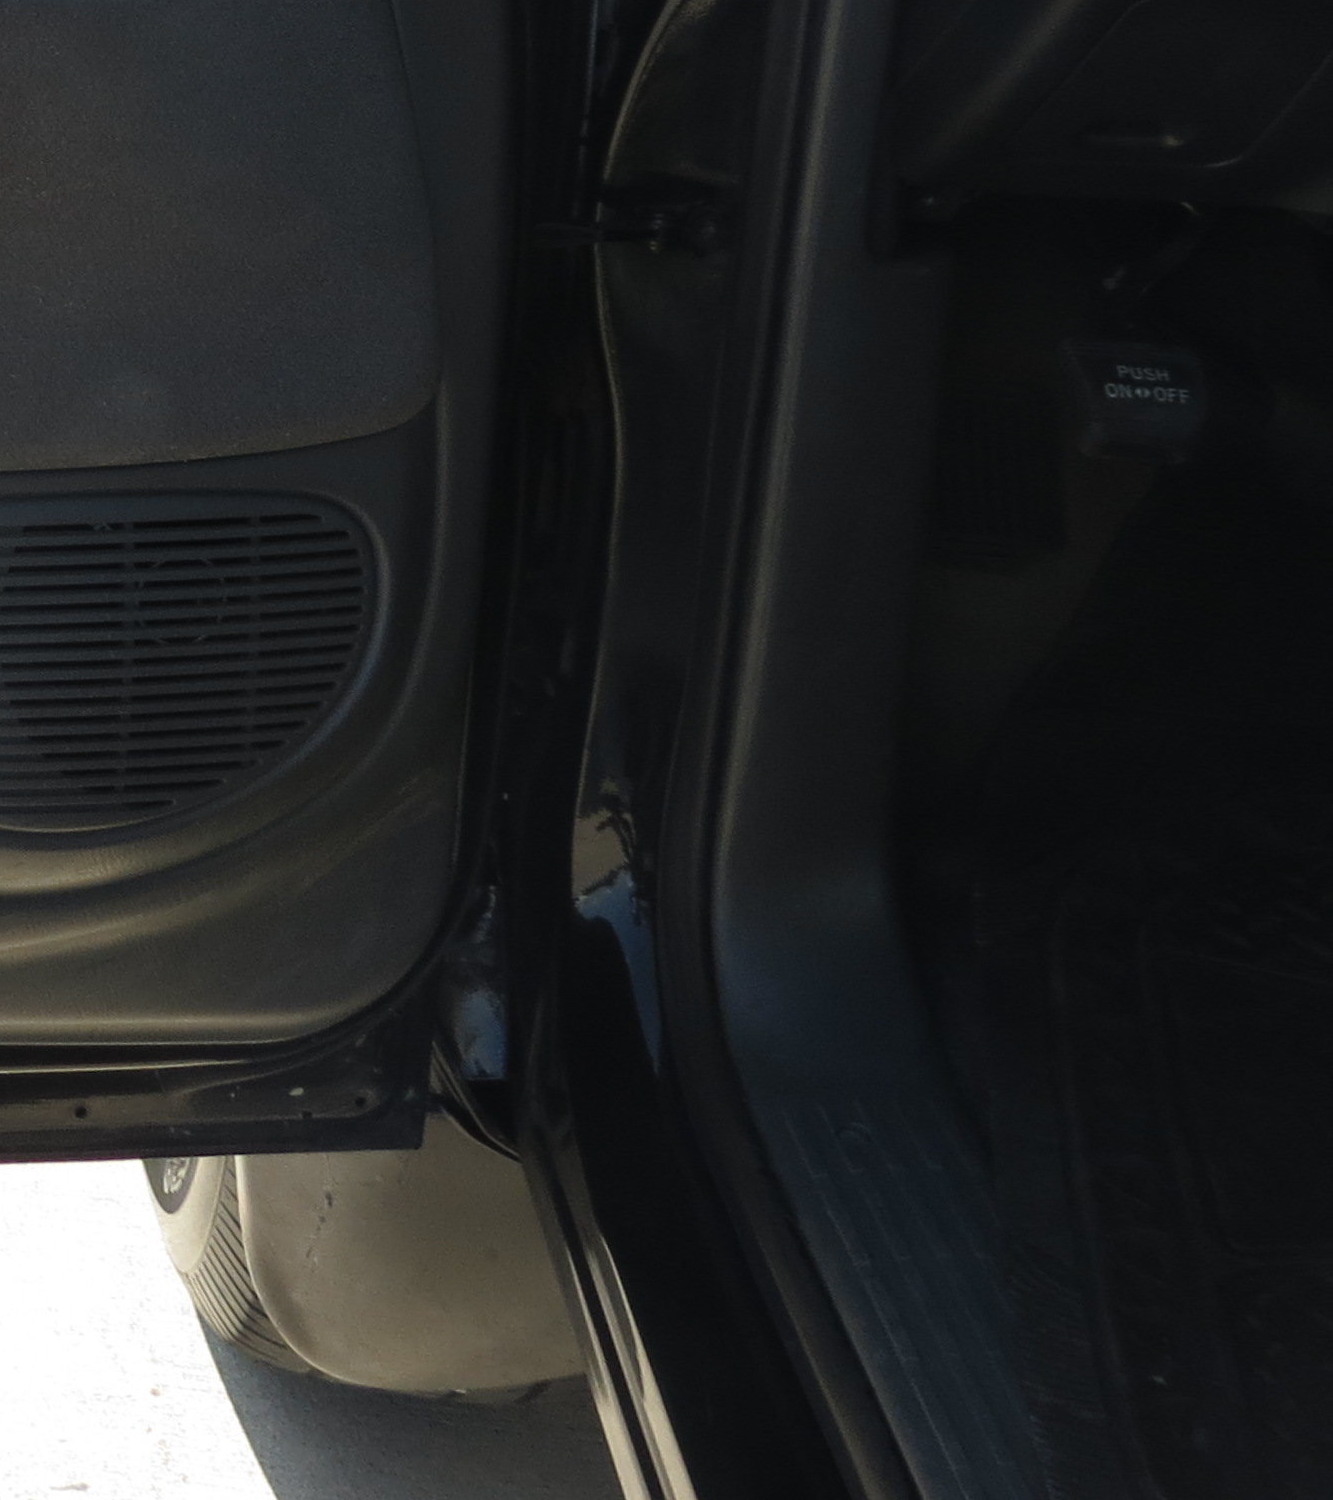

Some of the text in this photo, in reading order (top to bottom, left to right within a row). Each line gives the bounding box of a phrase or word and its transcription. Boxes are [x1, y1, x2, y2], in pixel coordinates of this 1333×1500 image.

[1116, 365, 1170, 381] PUSH
[1104, 382, 1190, 403] ON OFF
